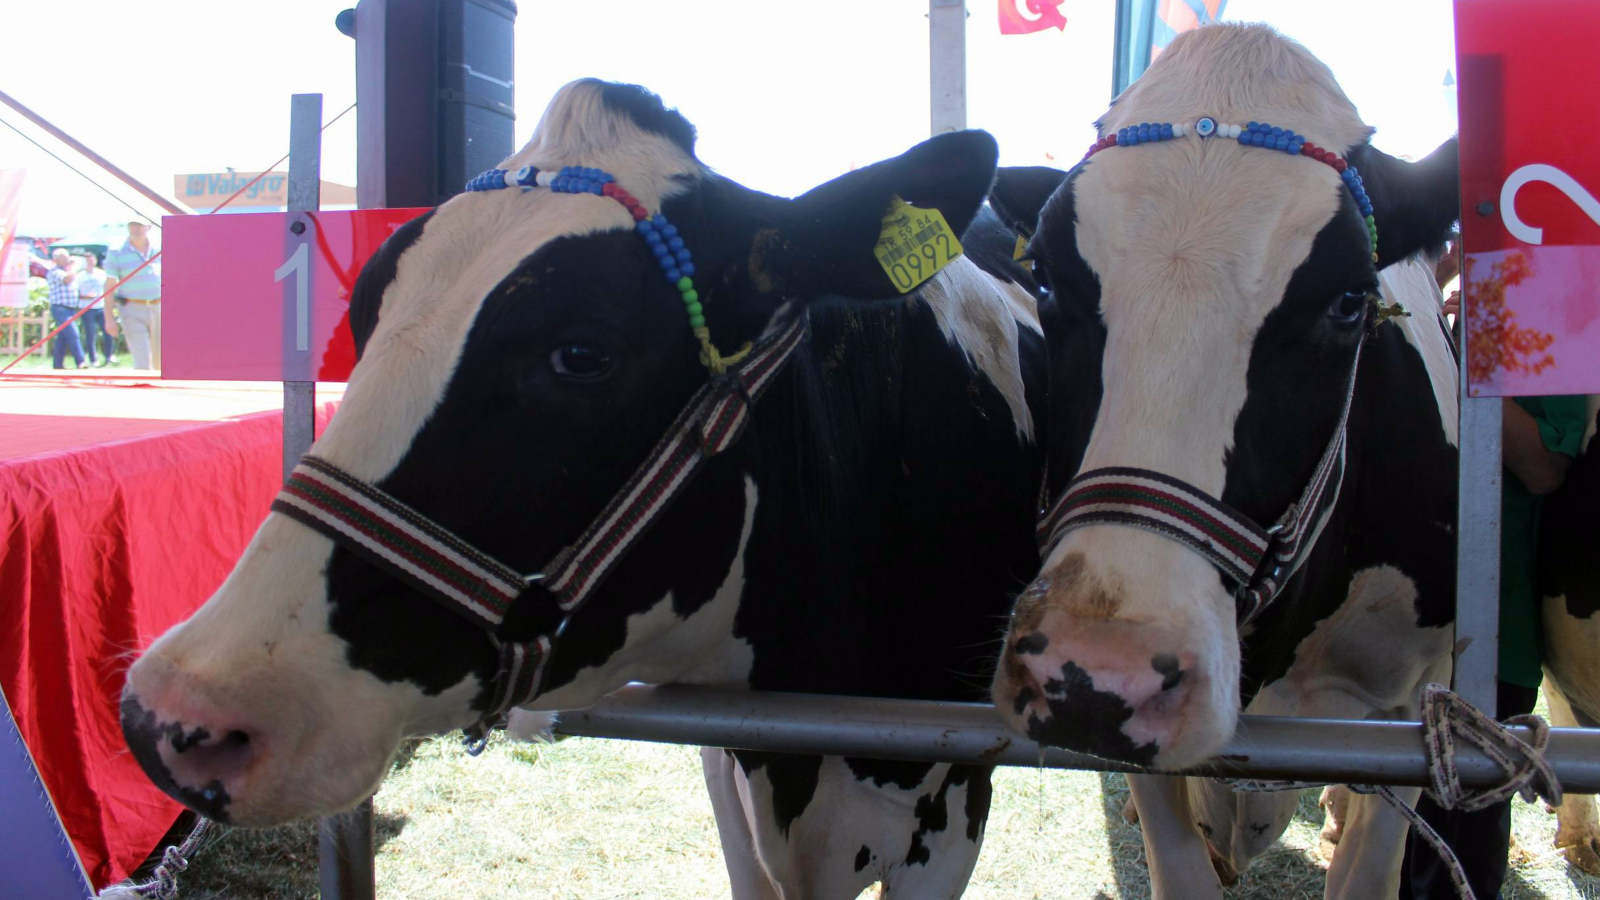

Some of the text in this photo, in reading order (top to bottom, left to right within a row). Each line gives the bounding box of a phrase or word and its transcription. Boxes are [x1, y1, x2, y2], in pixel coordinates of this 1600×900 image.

[207, 173, 285, 199] Valagro
[899, 226, 913, 241] 59
[916, 214, 931, 229] 84
[891, 233, 959, 289] 0992
[274, 242, 309, 351] 1
